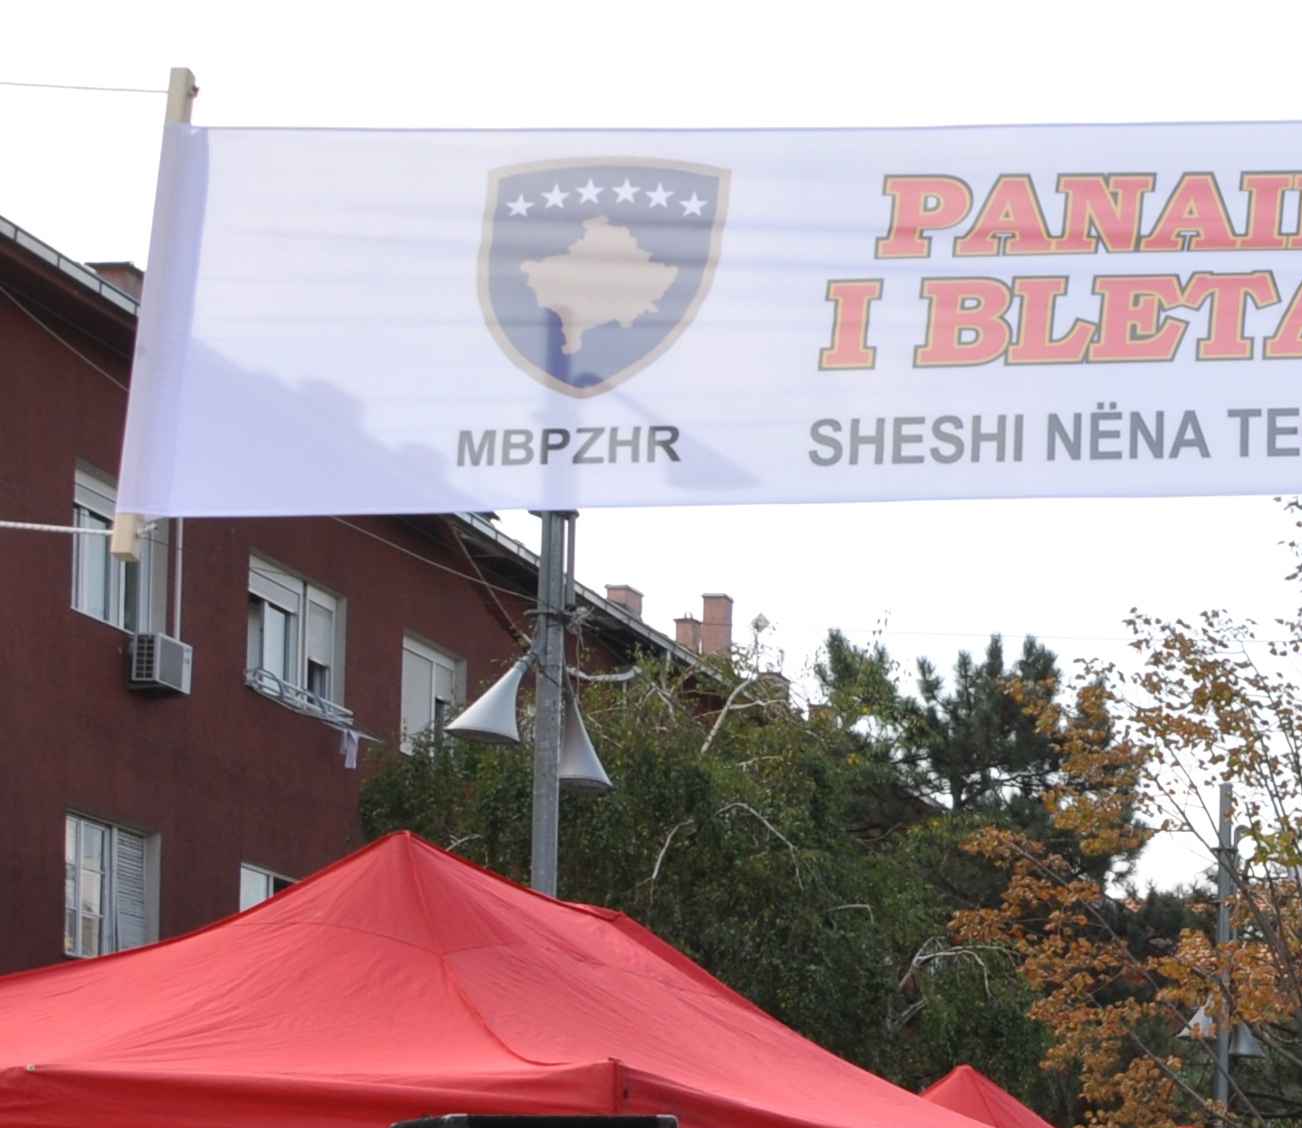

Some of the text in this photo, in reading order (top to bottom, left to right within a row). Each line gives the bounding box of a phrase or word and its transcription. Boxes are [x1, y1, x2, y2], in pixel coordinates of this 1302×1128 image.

[818, 277, 884, 371] I
[456, 424, 681, 468] MBPZHR
[808, 414, 1023, 467] SHESHI
[1046, 401, 1211, 463] NËNA
